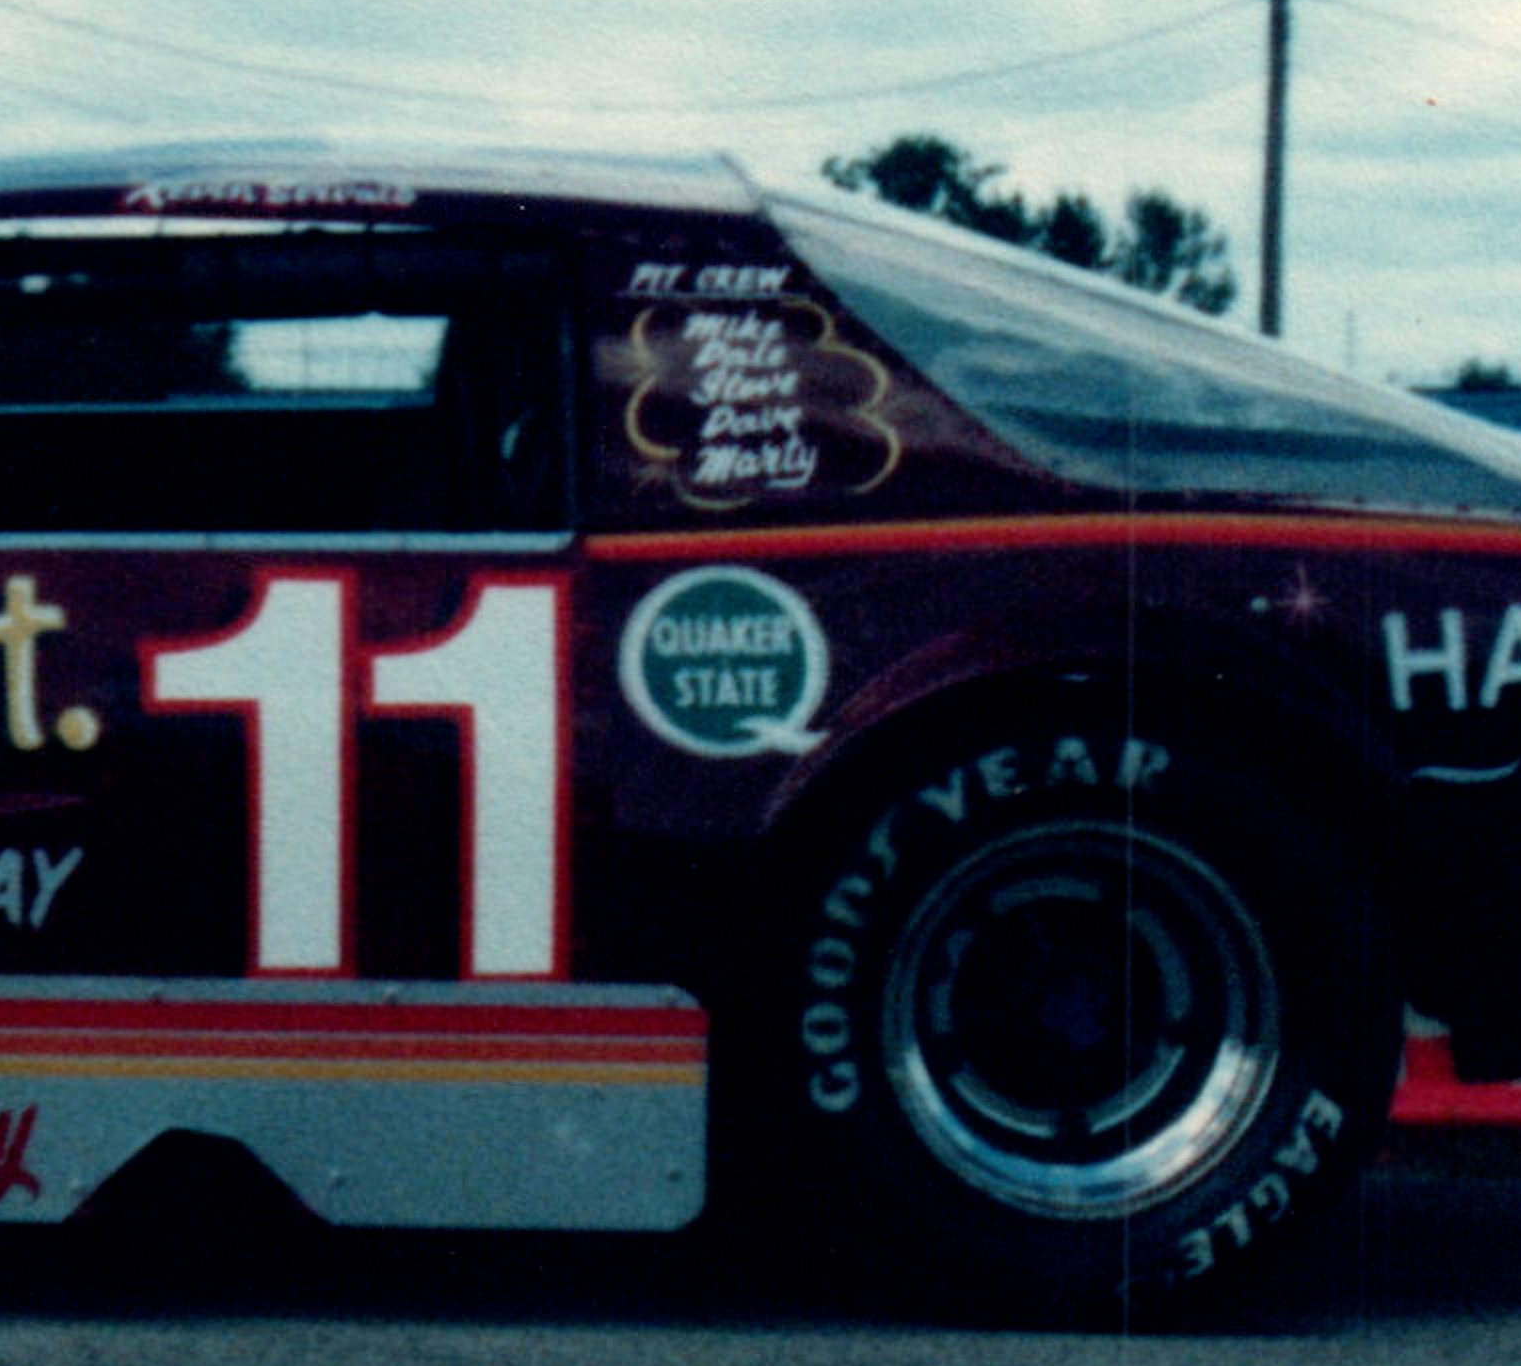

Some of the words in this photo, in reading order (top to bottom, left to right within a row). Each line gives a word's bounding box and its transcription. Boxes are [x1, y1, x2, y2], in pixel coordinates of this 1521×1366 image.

[629, 262, 686, 293] PIT
[694, 263, 792, 294] CREW
[682, 311, 784, 343] Mike
[700, 405, 803, 440] Dave
[692, 435, 817, 490] Marty
[656, 614, 794, 657] QUAKER
[672, 665, 780, 710] STATE
[138, 566, 573, 979] 11
[1173, 1087, 1345, 1279] EAGLE
